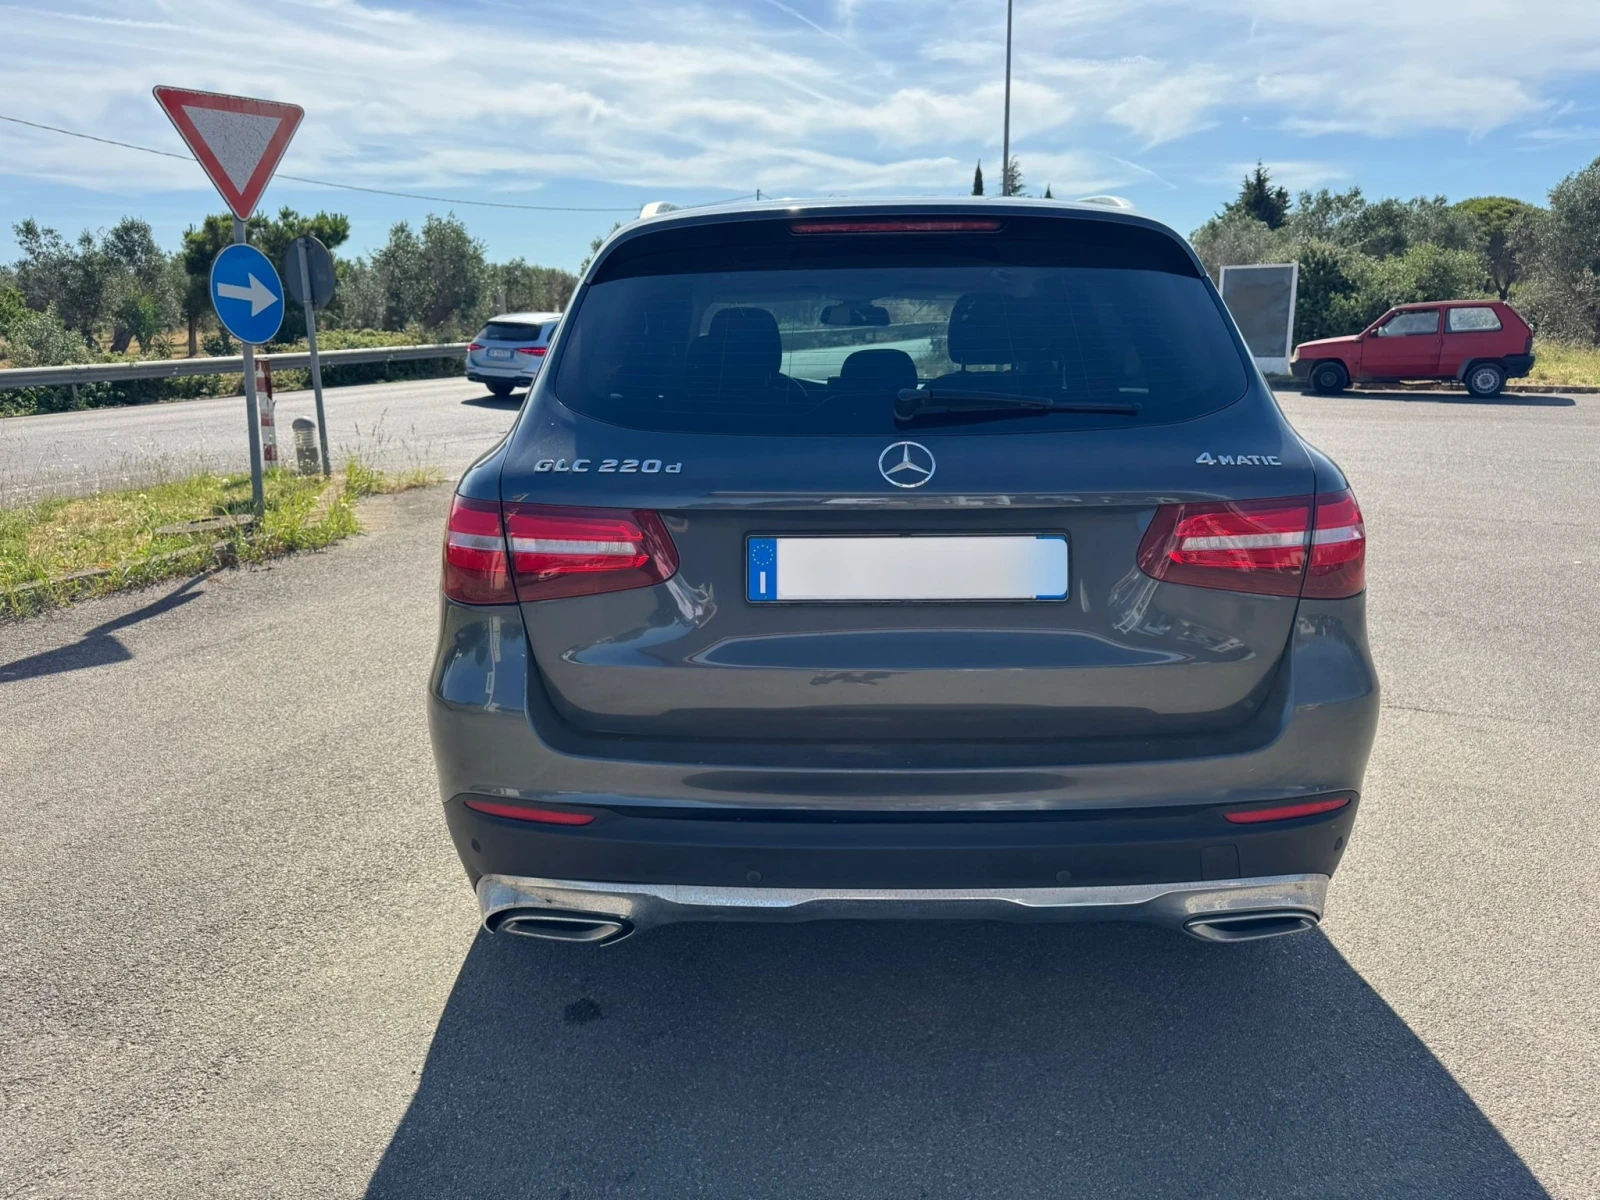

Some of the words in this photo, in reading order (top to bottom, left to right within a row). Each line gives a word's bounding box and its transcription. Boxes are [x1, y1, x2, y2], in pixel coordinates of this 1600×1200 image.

[533, 458, 592, 473] GLC
[598, 458, 683, 474] 220d
[760, 571, 766, 594] I
